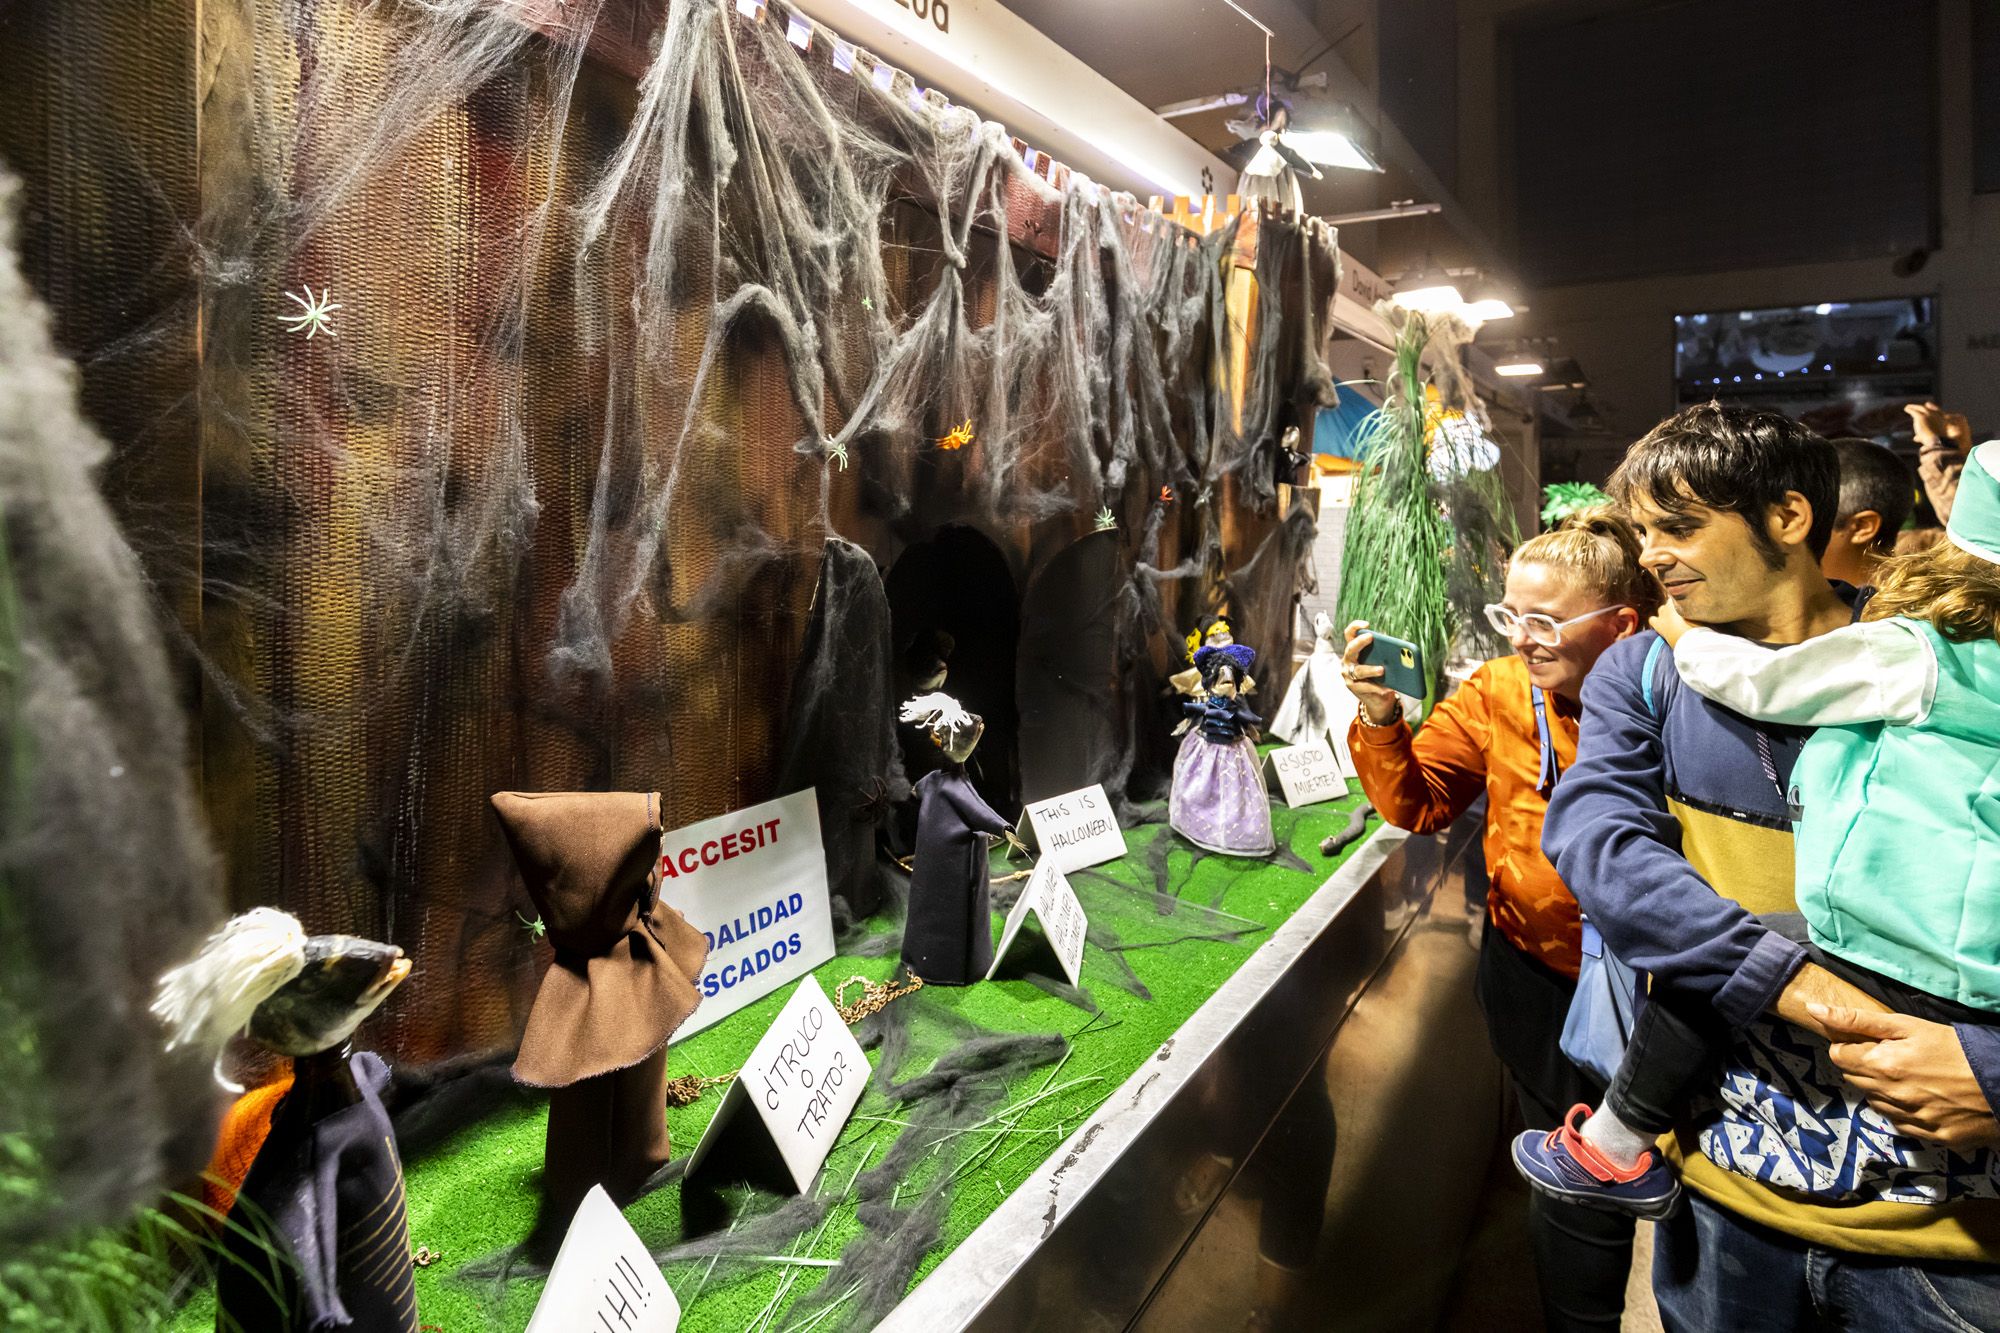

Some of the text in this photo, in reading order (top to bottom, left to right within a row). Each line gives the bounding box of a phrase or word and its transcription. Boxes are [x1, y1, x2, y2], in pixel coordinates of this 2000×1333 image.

[1302, 767, 1311, 777] O
[1035, 794, 1096, 823] THIS IS
[1050, 815, 1114, 852] HALLOWEEN
[758, 1006, 823, 1111] ¿TRUCO
[797, 1051, 853, 1140] TRATO?
[801, 1069, 814, 1089] O
